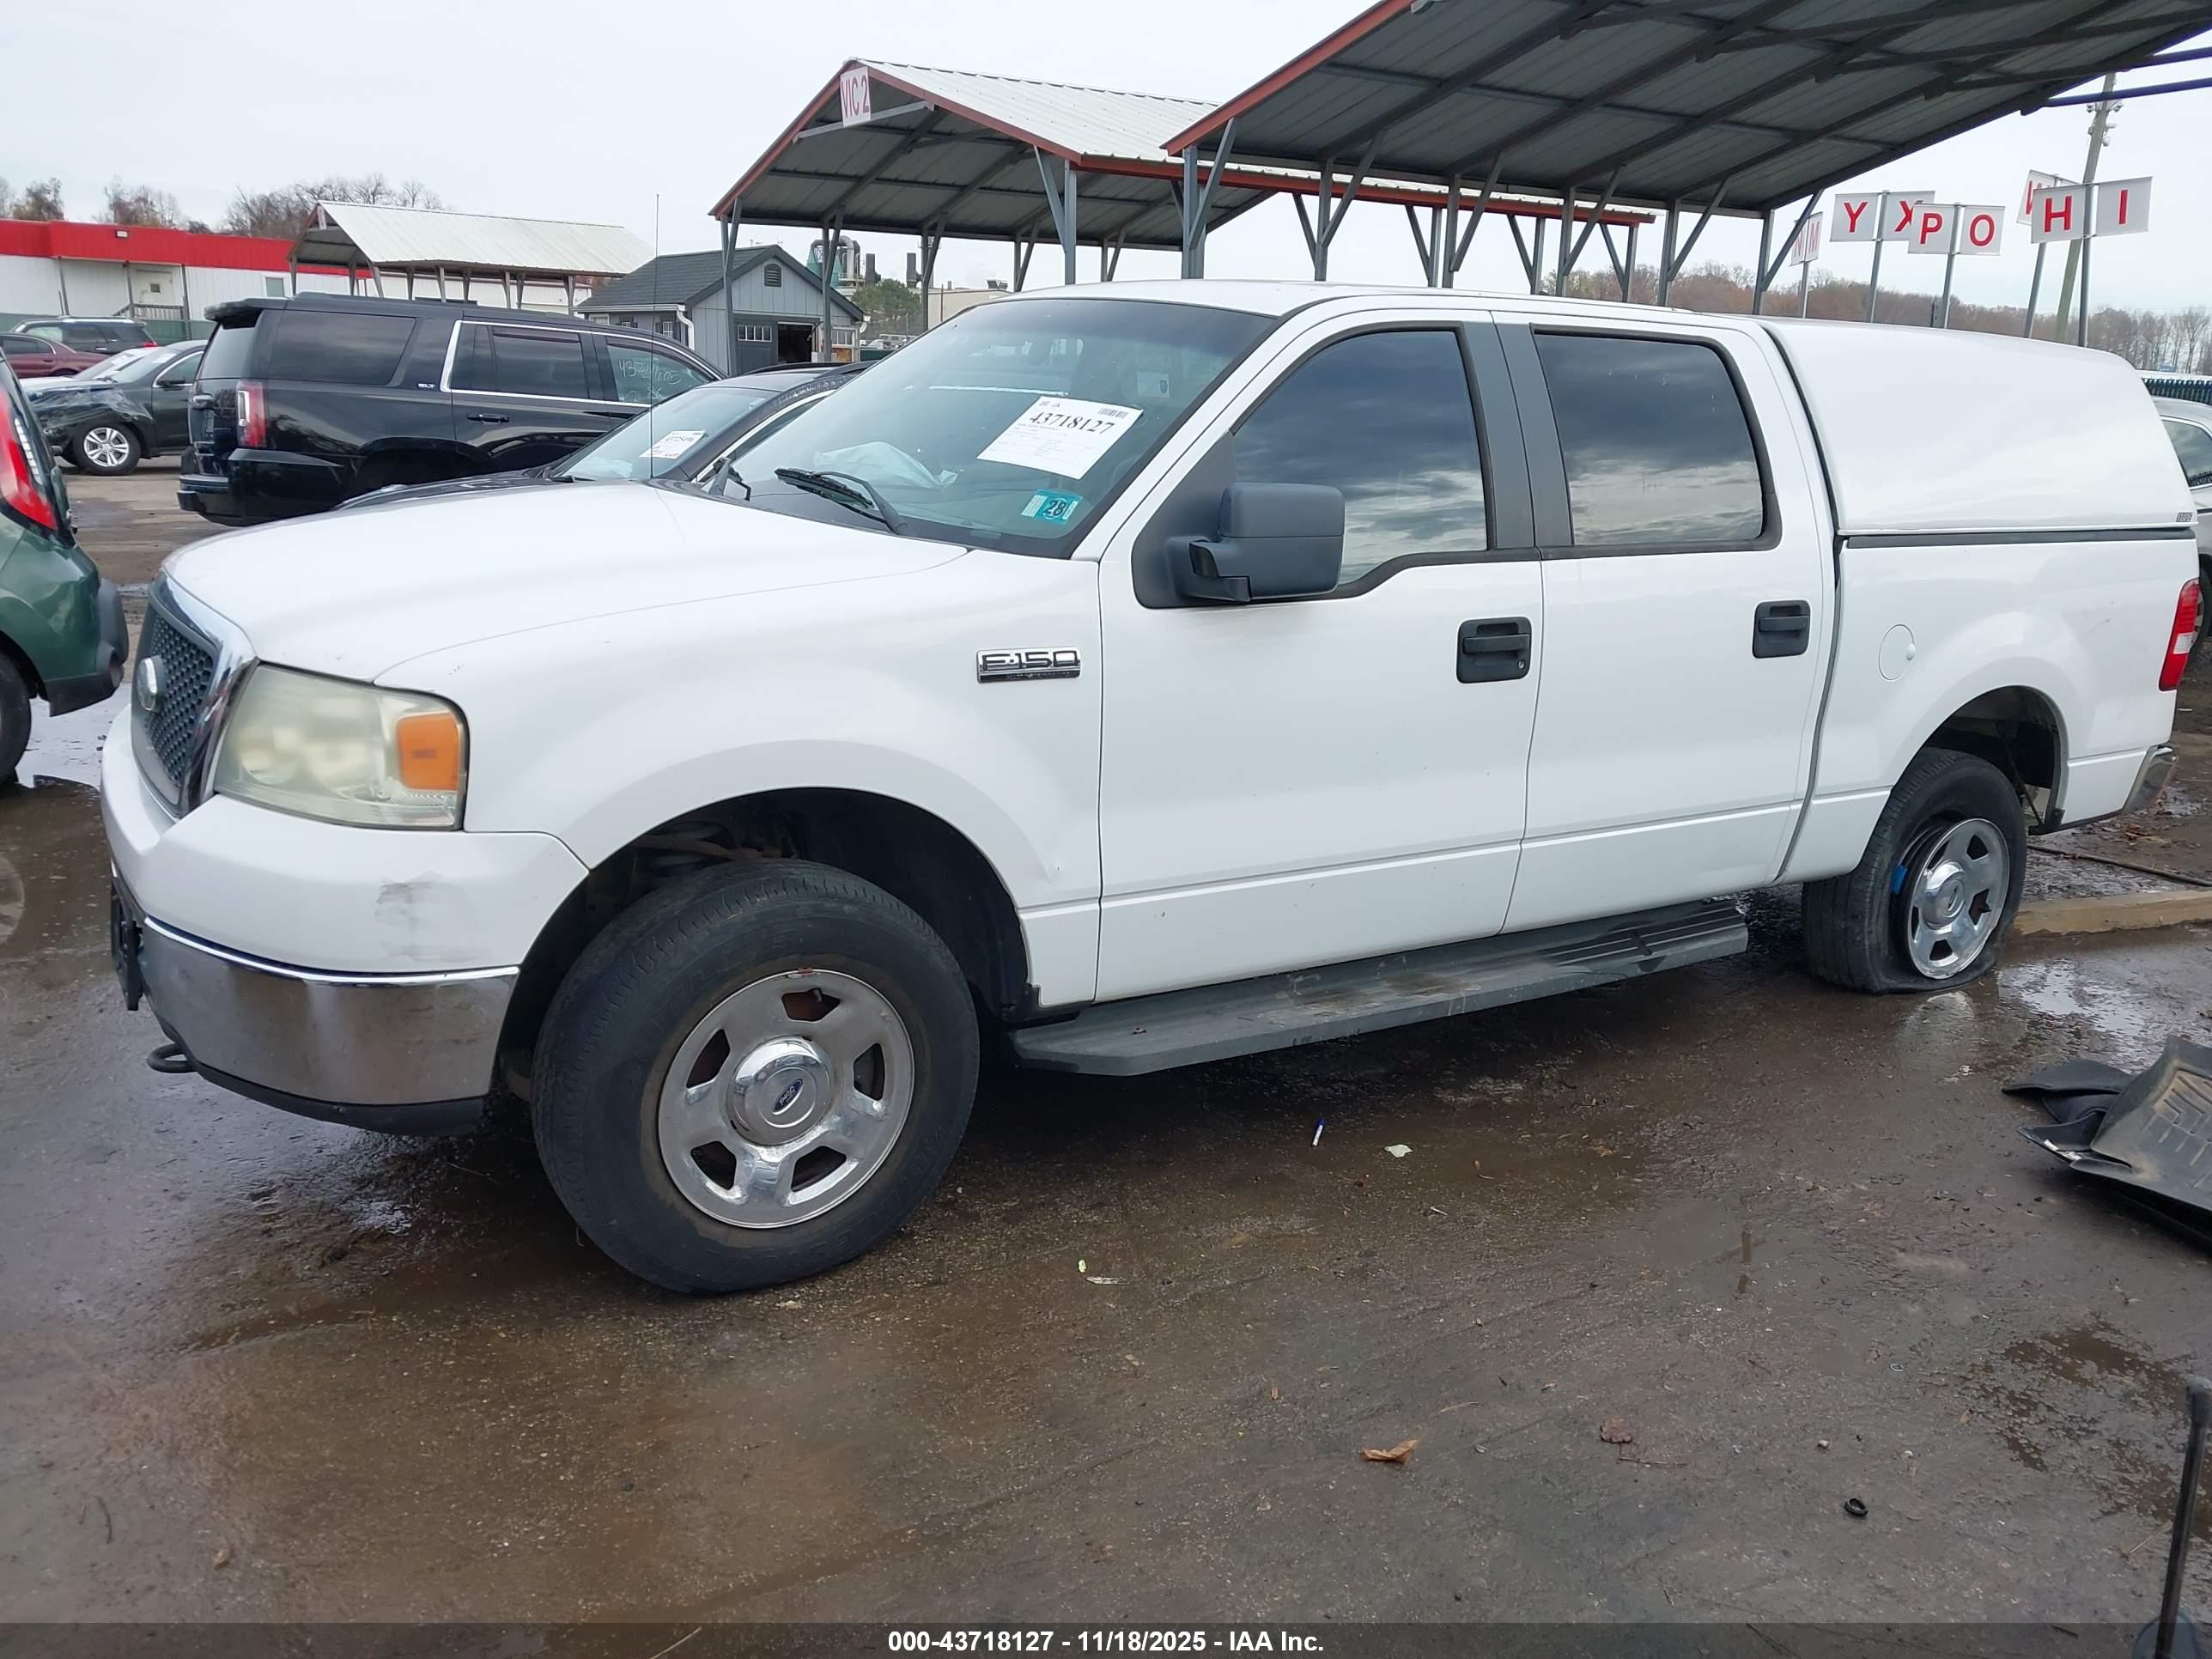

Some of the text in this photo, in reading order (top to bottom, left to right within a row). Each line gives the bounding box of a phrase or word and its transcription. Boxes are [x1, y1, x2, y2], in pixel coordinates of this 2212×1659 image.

[842, 75, 869, 118] VIC 2
[1844, 201, 1868, 233] Y
[2045, 196, 2072, 233] H
[2118, 189, 2128, 225] I
[1920, 213, 1943, 245] P
[1970, 214, 1995, 246] O
[1030, 411, 1115, 434] 43718127
[1043, 500, 1066, 516] 28
